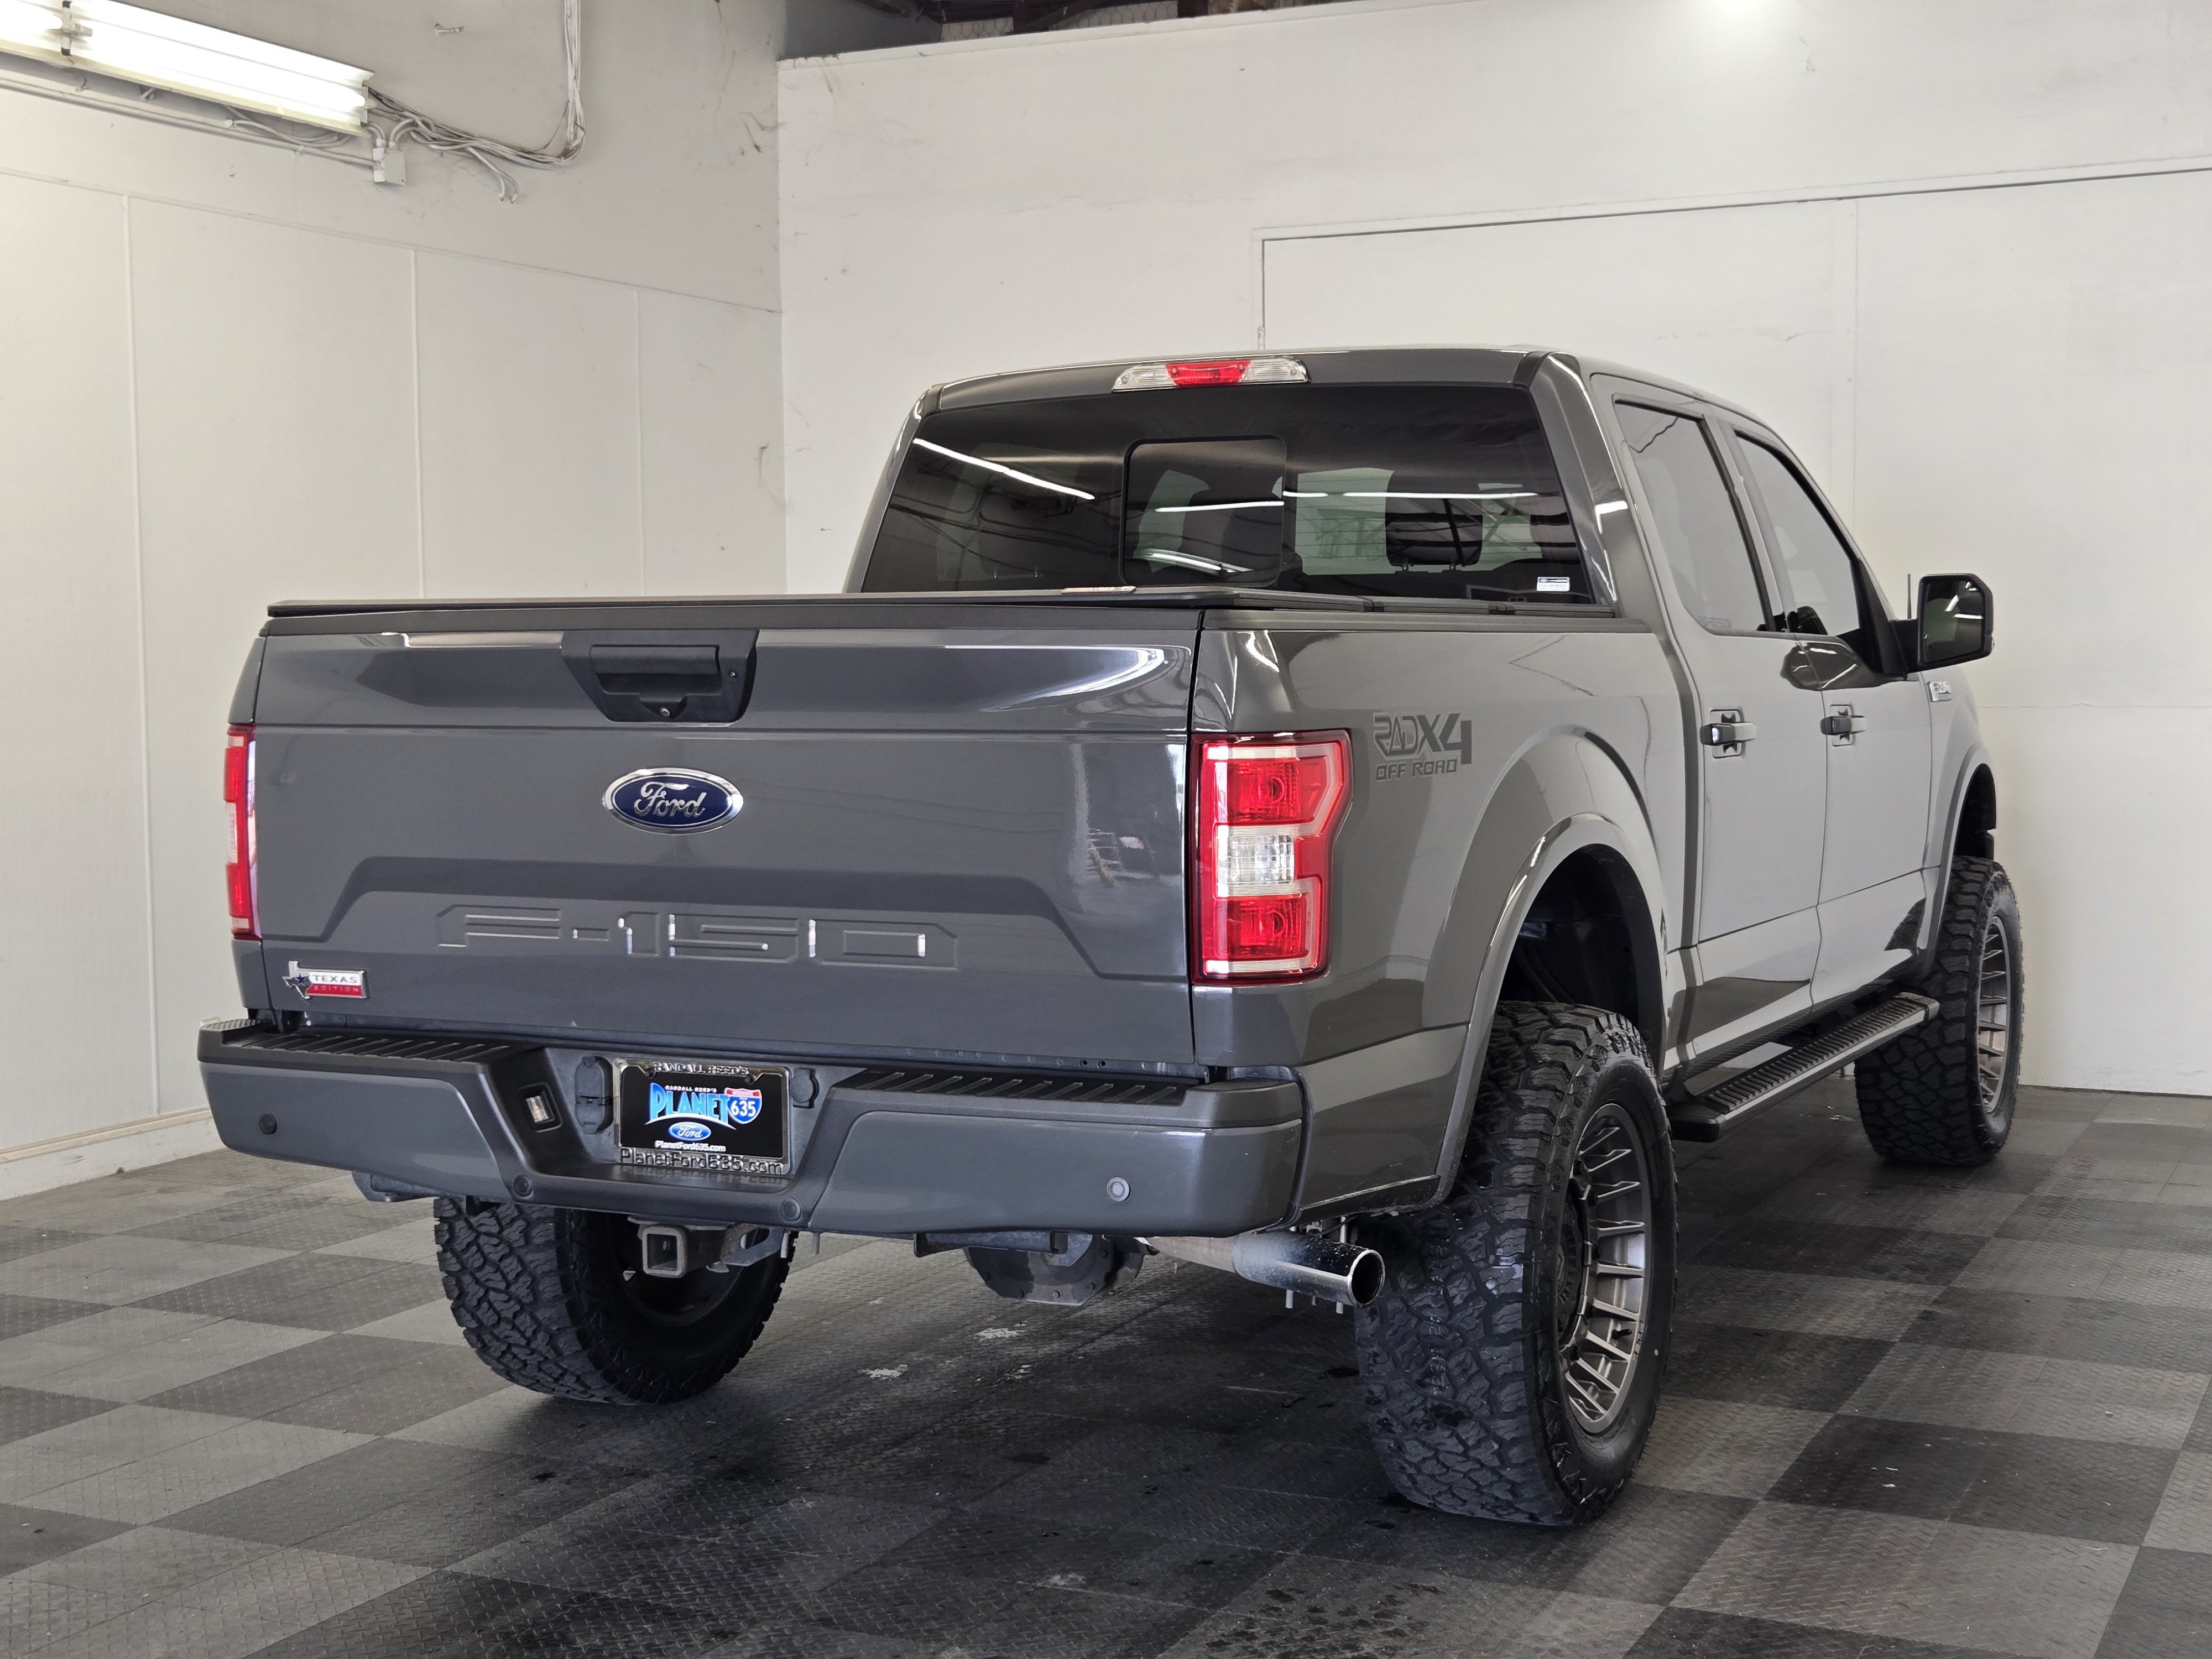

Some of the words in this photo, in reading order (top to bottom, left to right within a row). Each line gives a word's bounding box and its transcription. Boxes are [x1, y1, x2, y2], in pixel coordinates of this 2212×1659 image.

[1376, 764, 1406, 781] OFF
[1412, 759, 1457, 777] ROAD
[634, 781, 707, 817] Ford
[314, 975, 358, 983] TEXAS
[649, 1082, 731, 1124] PLANET
[731, 1100, 757, 1117] 635
[676, 1124, 703, 1139] Ford
[655, 1140, 727, 1152] PlanetFord635.com
